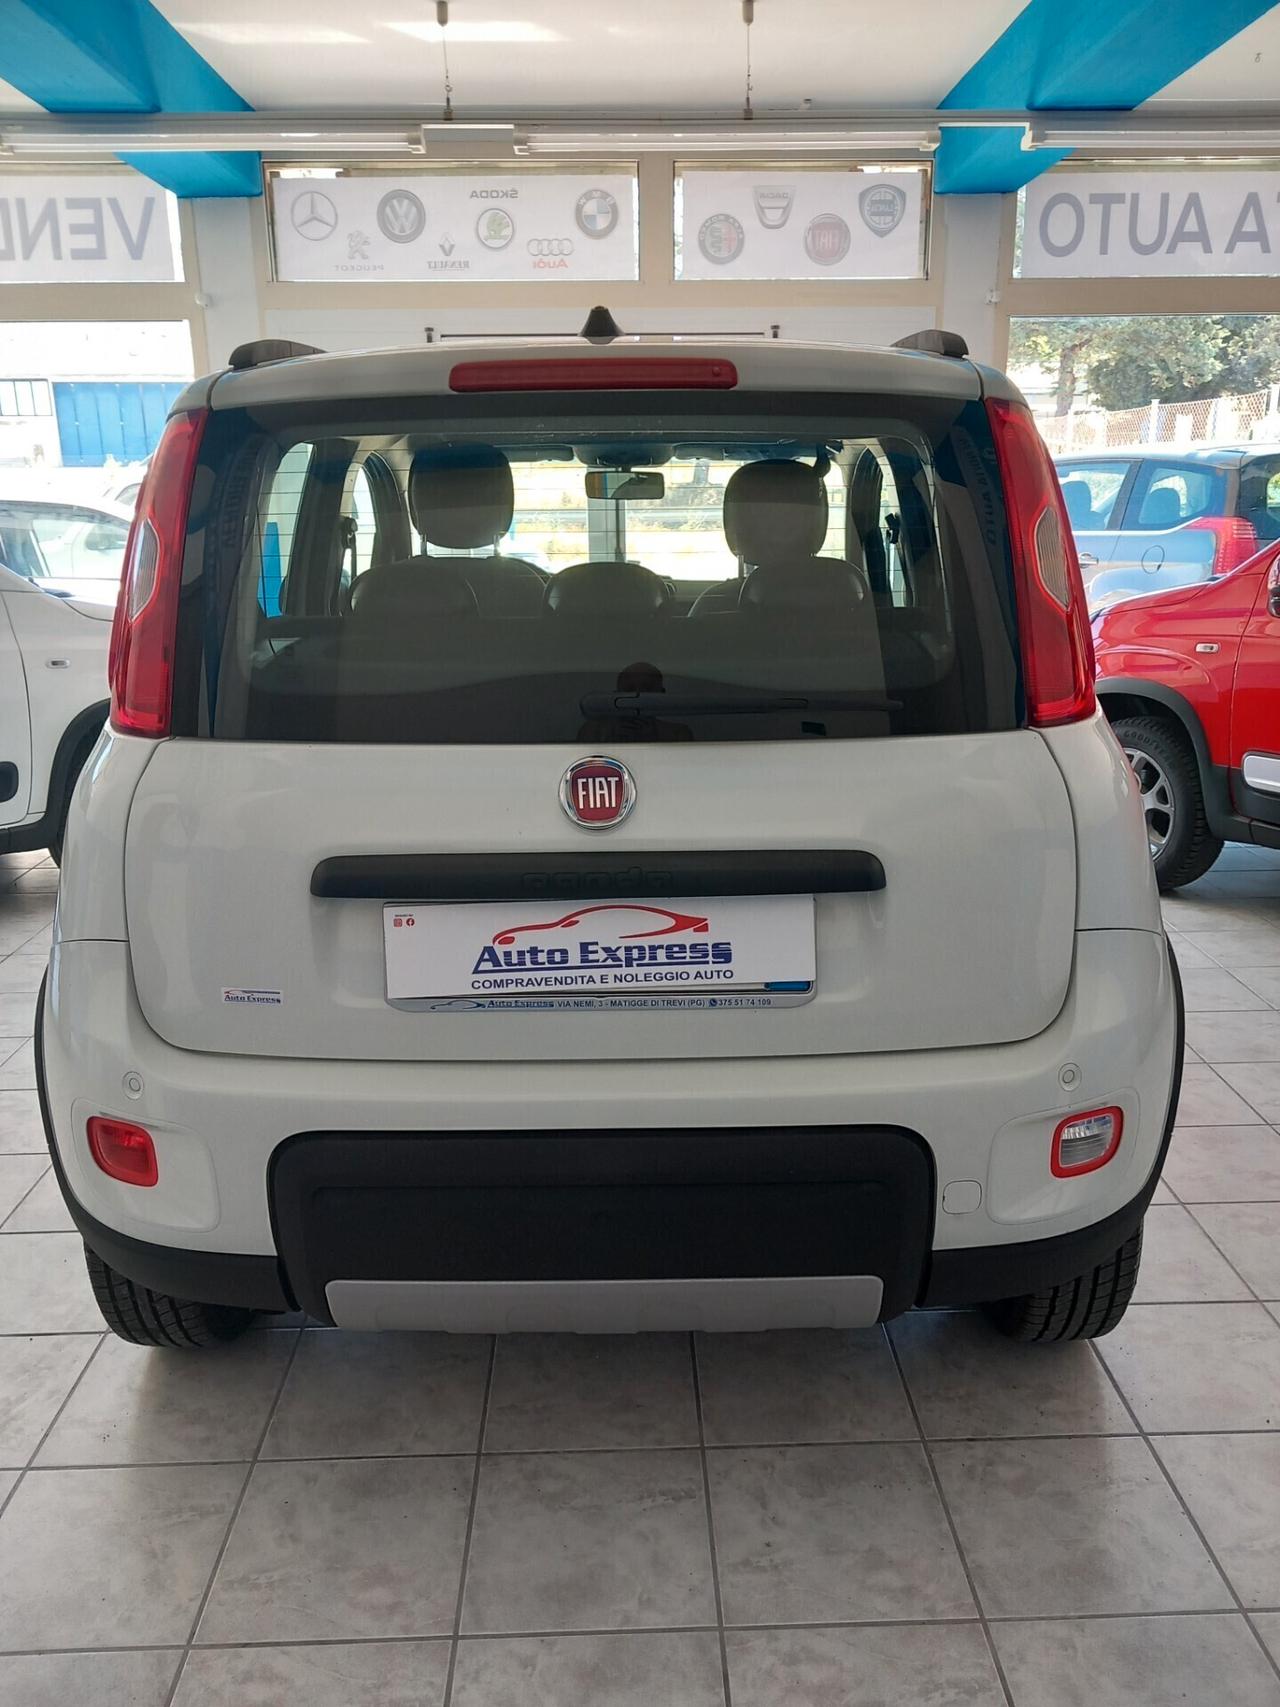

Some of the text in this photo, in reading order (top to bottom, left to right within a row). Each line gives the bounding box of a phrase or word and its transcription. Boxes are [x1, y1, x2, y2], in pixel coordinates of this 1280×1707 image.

[577, 776, 619, 809] FIAT
[472, 941, 733, 974] Auto Express
[471, 969, 734, 990] COMPRAVENDITA E NOLEGGIO AUTO
[557, 1000, 571, 1008] VIA
[610, 1000, 648, 1008] MATIGGE
[650, 999, 660, 1007] DI
[661, 999, 686, 1007] TREVI
